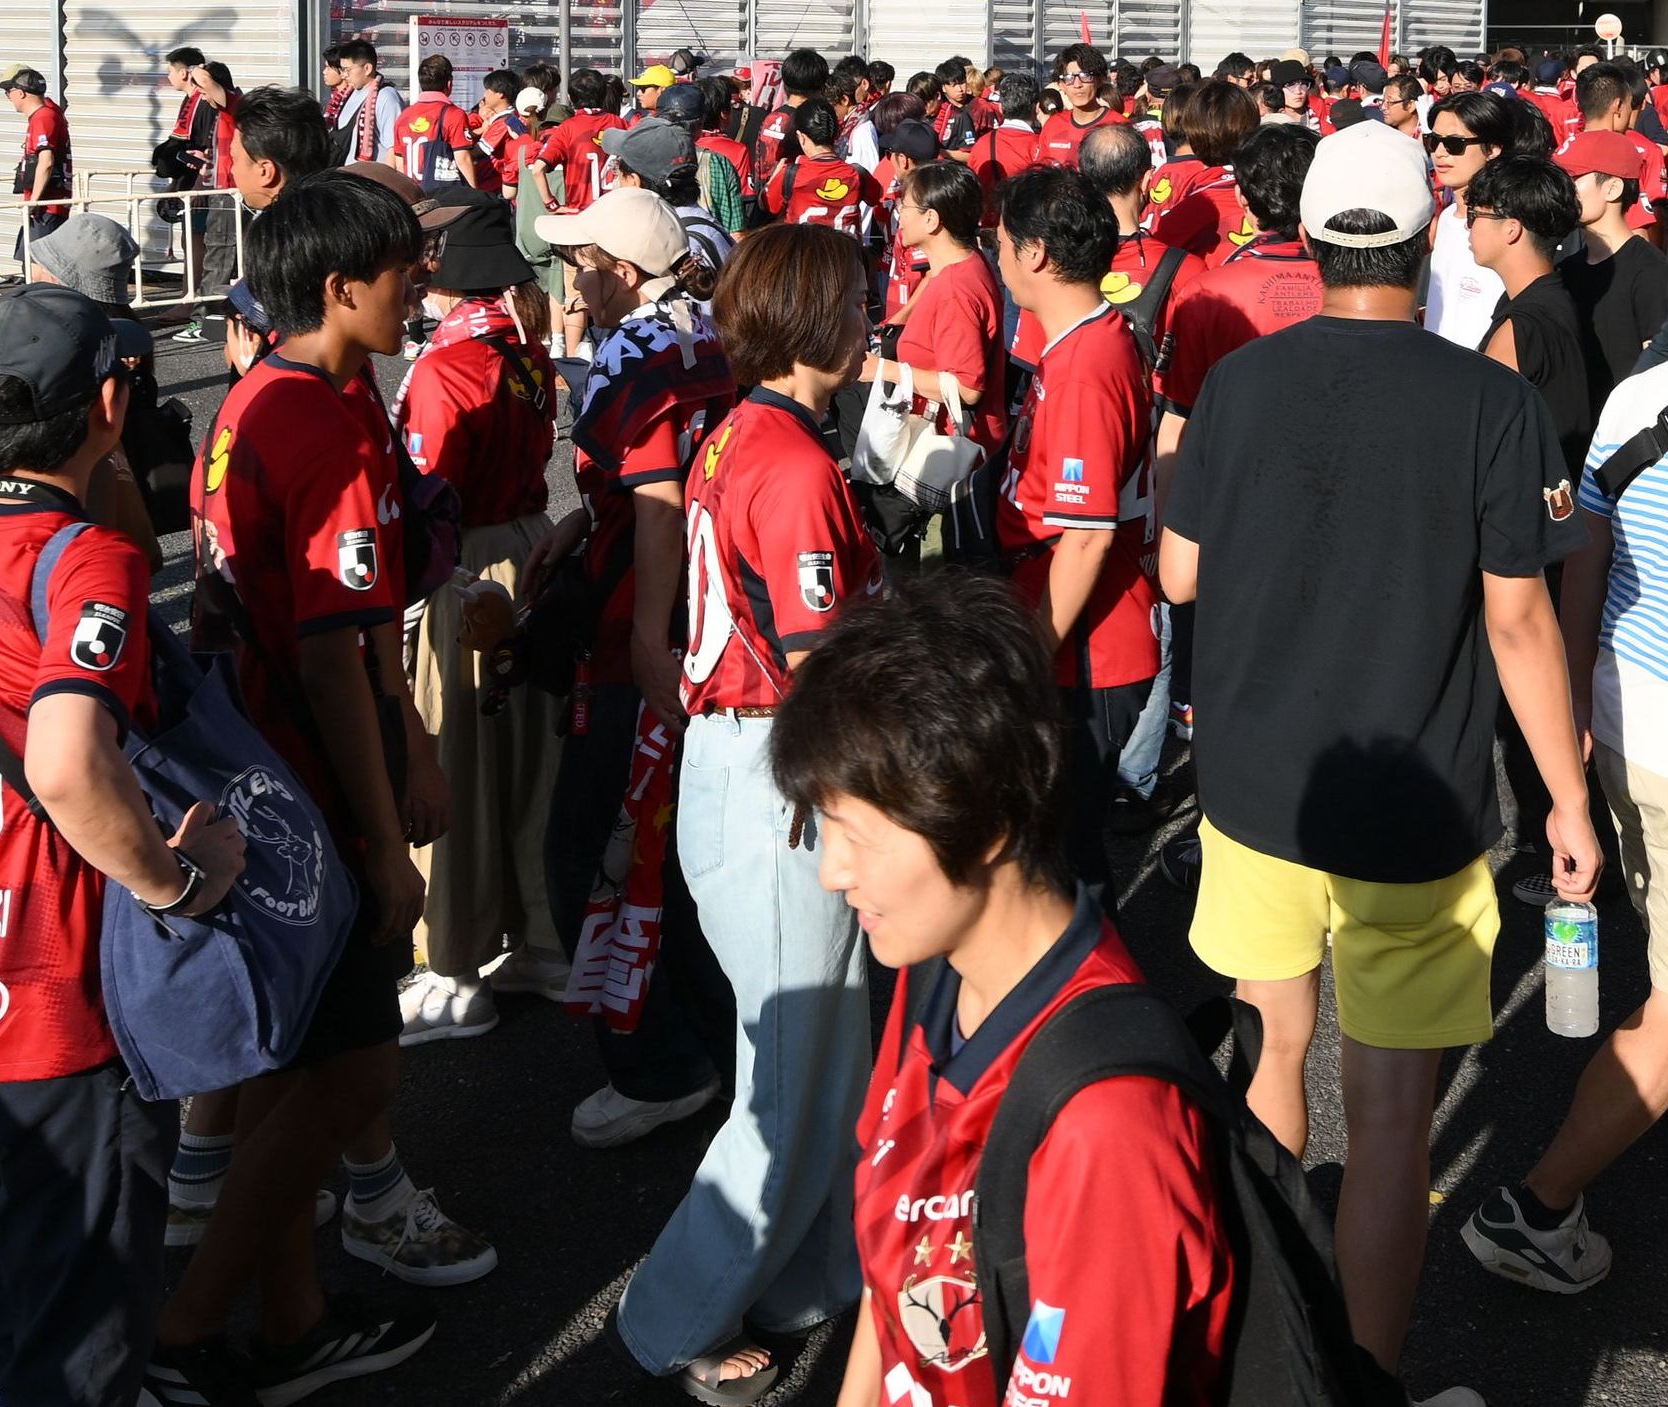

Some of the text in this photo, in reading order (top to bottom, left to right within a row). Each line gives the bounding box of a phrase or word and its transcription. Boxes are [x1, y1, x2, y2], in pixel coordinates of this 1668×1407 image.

[1054, 482, 1090, 495] NIPPON
[1055, 493, 1086, 505] STEEL
[1551, 943, 1581, 958] GREEN
